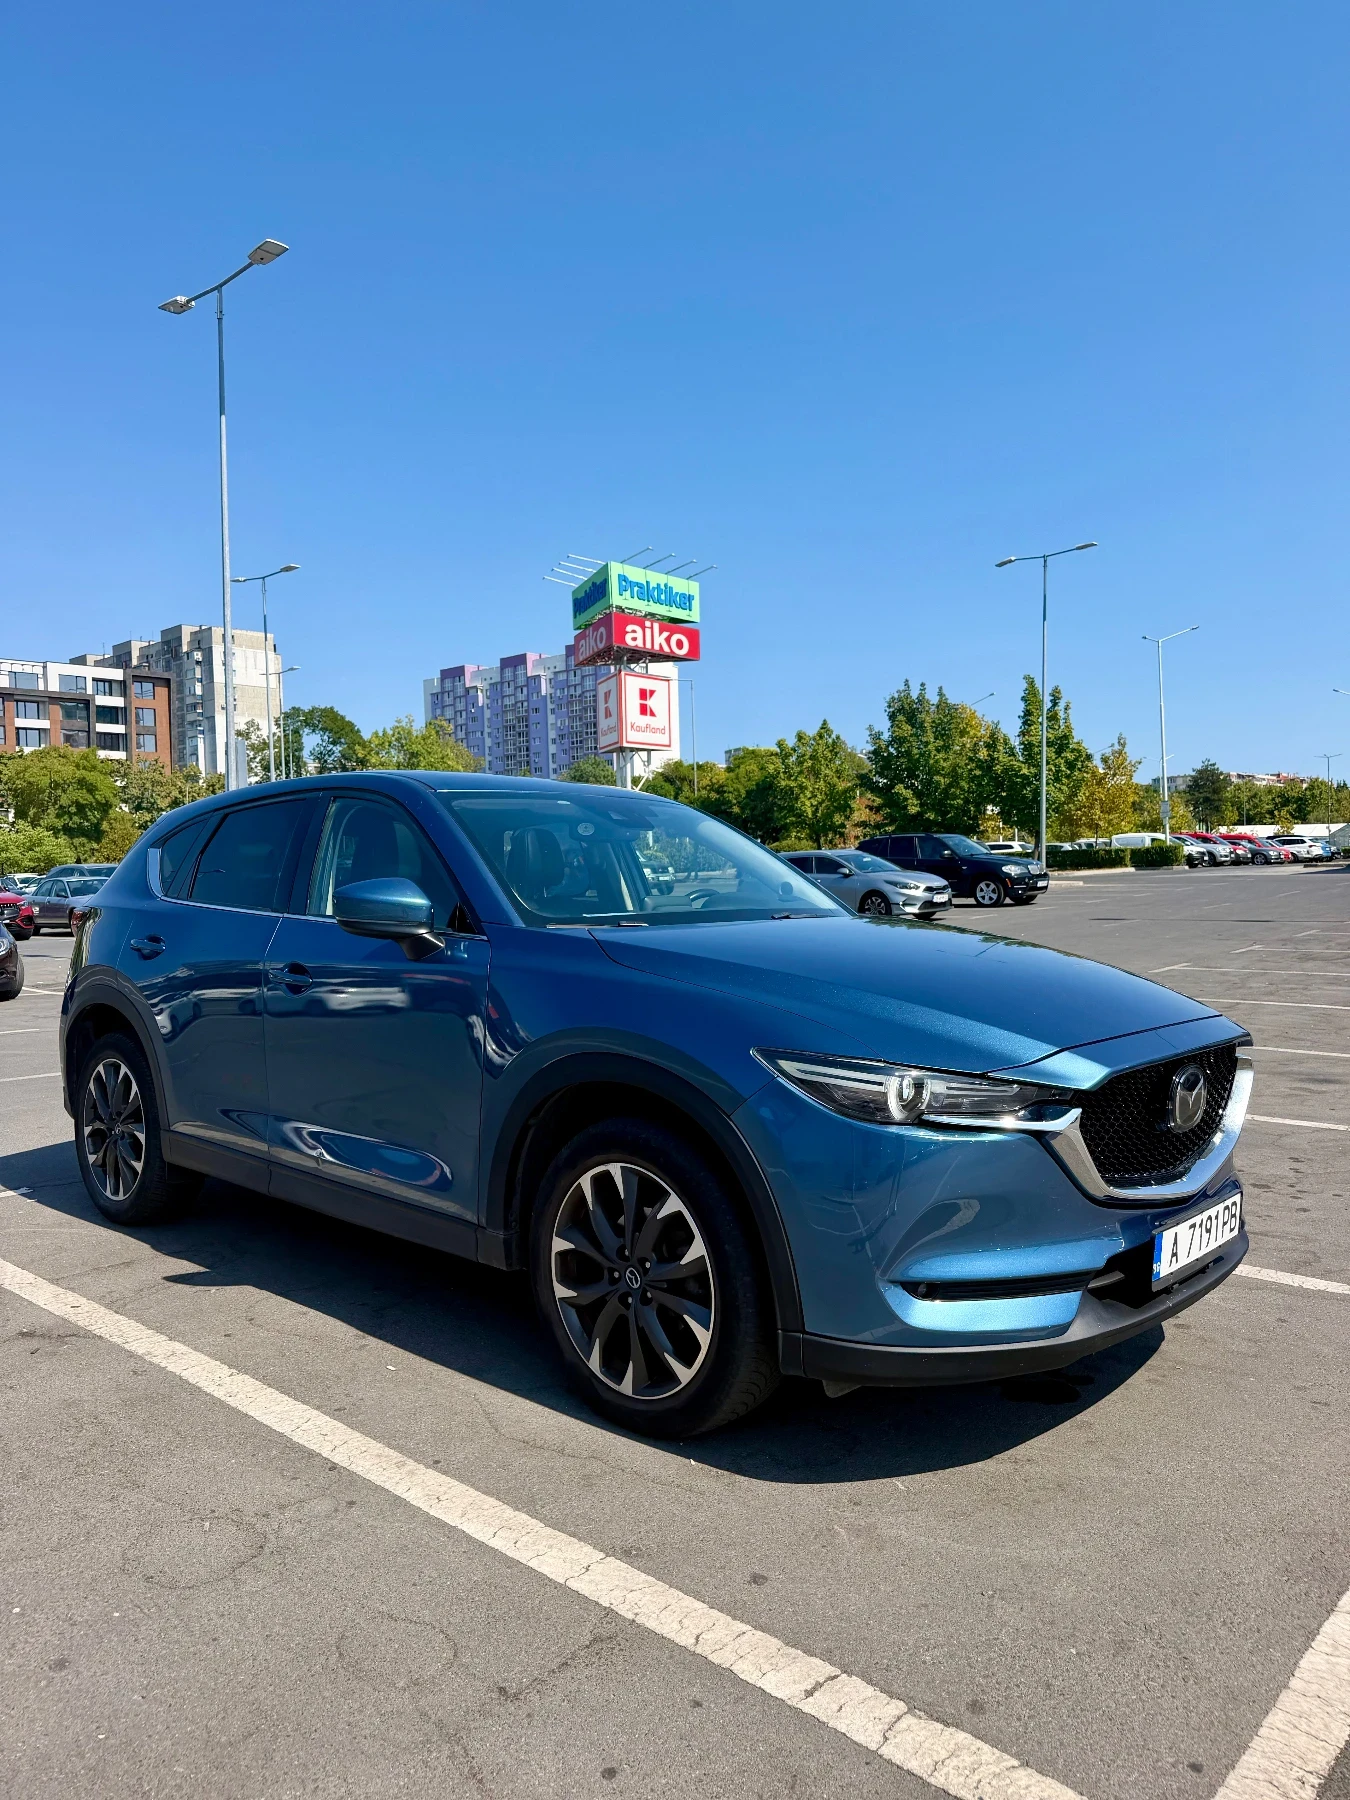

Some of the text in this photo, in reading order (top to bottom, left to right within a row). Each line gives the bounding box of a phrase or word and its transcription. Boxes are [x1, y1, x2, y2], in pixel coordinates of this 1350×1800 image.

[617, 573, 695, 612] Praktiker
[578, 627, 606, 660] aiko
[624, 620, 690, 656] aiko
[639, 688, 657, 717] K
[630, 721, 666, 735] Kaufland
[1168, 1231, 1179, 1268] A
